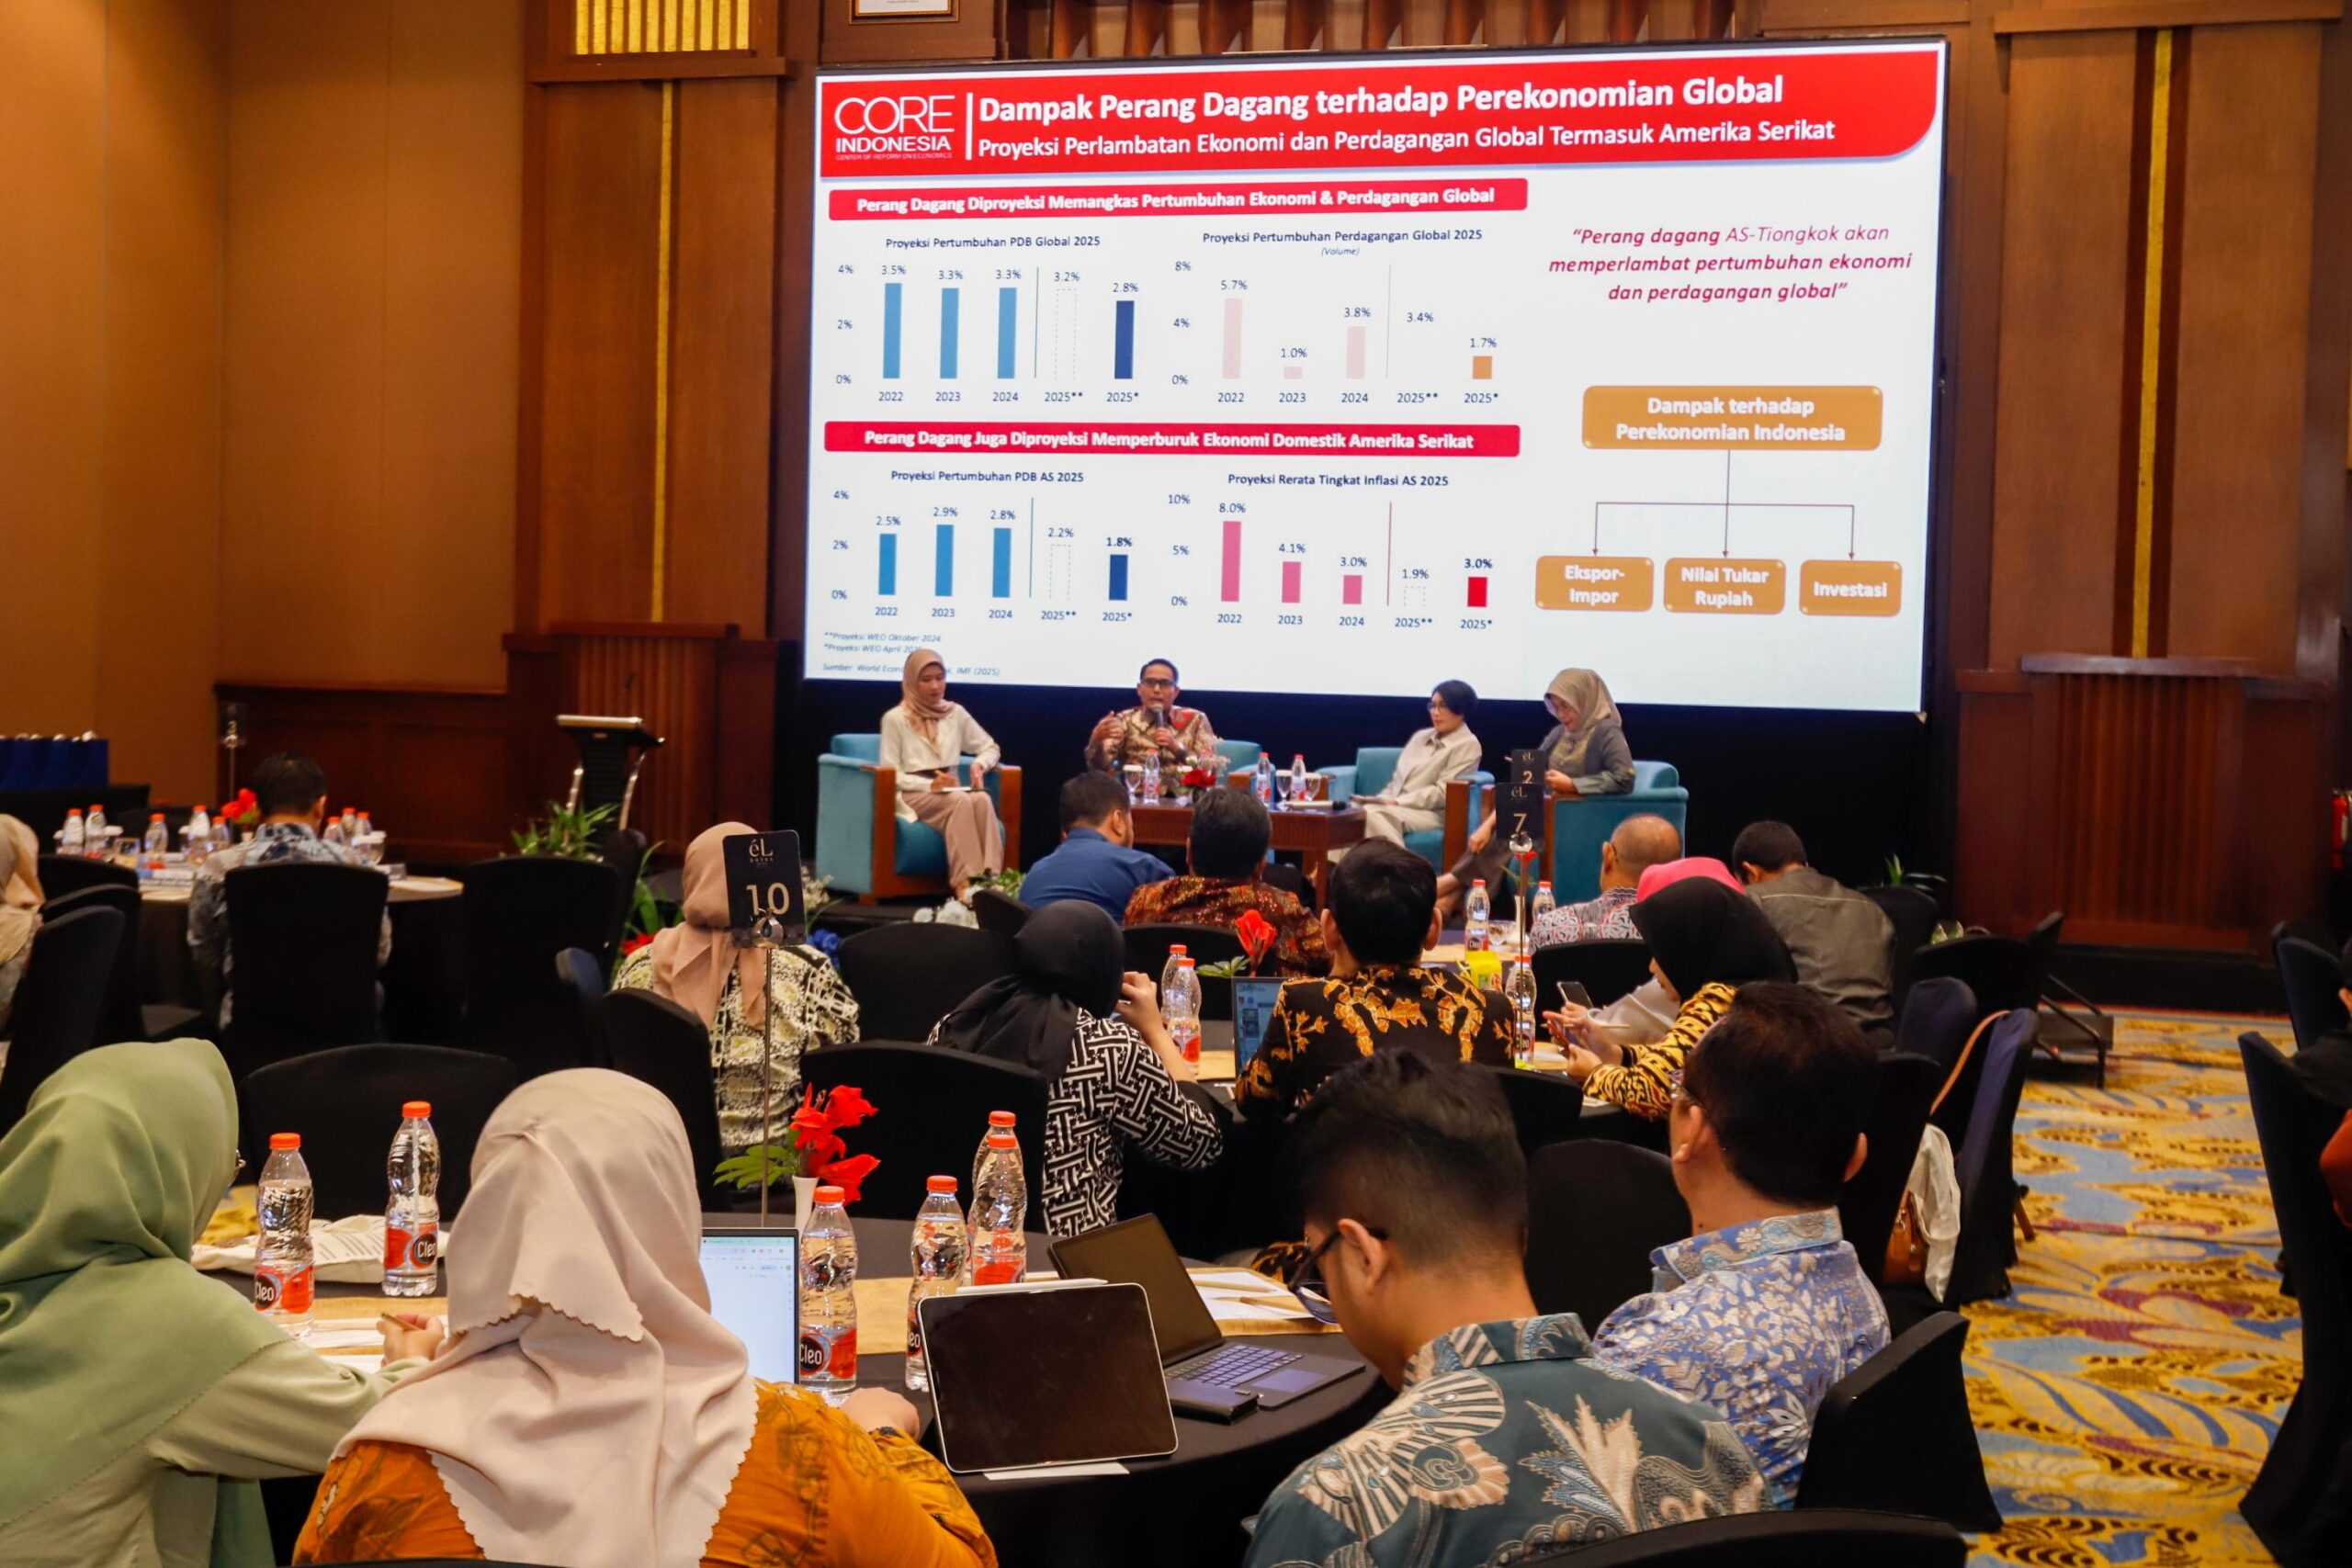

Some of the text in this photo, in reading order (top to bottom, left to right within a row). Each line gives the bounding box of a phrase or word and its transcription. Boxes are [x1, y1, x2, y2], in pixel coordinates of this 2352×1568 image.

[980, 75, 1782, 126] Dampak Perang Dagang terhadap Perekonomian Global
[834, 95, 956, 135] CORE
[836, 135, 951, 152] INDONESIA
[979, 119, 1835, 160] Proyeksi Perlambatan Ekonomi dan Perdagangan Global Termasuk Amerika Serikat
[858, 187, 1494, 214] Perang Dagang Diproyeksi Memangkas Pertumbuhan Ekonomi & Perdagangan Global
[1204, 230, 1482, 244] Proyeksi Pertumbuhan Perdagangan Global 2025
[1651, 228, 1720, 246] dagang
[1725, 225, 1838, 244] AS-Tiongkok
[1845, 225, 1889, 241] akan
[887, 236, 1100, 249] Proyeksi Pertumbuhan PDB Global 2025
[838, 265, 854, 274] 4%
[1175, 261, 1191, 271] 8%
[1549, 254, 1912, 275] memperlambat pertumbuhan ekonomi
[882, 265, 906, 275] 3.5%
[939, 270, 963, 279] 3.3%
[996, 269, 1021, 279] 3.3%
[1055, 272, 1080, 282] 3.2%
[1114, 283, 1138, 292] 2.8%
[1221, 280, 1247, 289] 5.7%
[1609, 285, 1642, 299] dan
[1647, 284, 1771, 303] perdagangan
[1344, 308, 1371, 317] 3.8%
[1408, 312, 1433, 322] 3.4%
[838, 320, 852, 329] 2%
[1173, 318, 1189, 327] 4%
[1471, 338, 1497, 347] 1.7%
[1282, 348, 1306, 357] 1.0%
[836, 375, 851, 384] 0%
[1172, 375, 1188, 384] 0%
[878, 391, 903, 401] 2022
[935, 392, 960, 401] 2023
[993, 392, 1018, 401] 2024
[1218, 392, 1244, 402] 2022
[1279, 392, 1306, 402] 2023
[1341, 393, 1368, 402] 2024
[1648, 397, 1815, 417] Dampak terhadap
[1616, 423, 1845, 441] Perekonomian Indonesia
[865, 431, 1474, 448] Perang Dagang Juga Diproyeksi Memperburuk Ekonomi Domestik Amerika Serikat
[891, 471, 1083, 481] Proyeksi Pertumbuhan PDB AS 2025
[1228, 474, 1448, 487] Proyeksi Rerata Tingkat Inflasi AS 2025
[834, 491, 849, 500] 4%
[1169, 494, 1190, 504] 10%
[933, 507, 958, 516] 2.9%
[1219, 503, 1246, 513] 8.0%
[990, 510, 1015, 520] 2.8%
[876, 516, 900, 525] 2.5%
[1048, 527, 1073, 537] 2.2%
[833, 540, 848, 549] 2%
[1107, 537, 1132, 547] 1.8%
[1173, 546, 1189, 555] 5%
[1279, 544, 1306, 553] 4.1%
[1340, 557, 1367, 567] 3.0%
[1464, 558, 1492, 569] 3.0%
[1403, 570, 1429, 579] 1.9%
[1565, 565, 1624, 582] Ekspor-
[1681, 567, 1769, 583] Nilai Tukar
[1814, 581, 1887, 597] Investasi
[831, 590, 847, 599] 0%
[1570, 589, 1619, 606] Impor
[1695, 591, 1753, 608] Rupiah
[1171, 596, 1188, 606] 0%
[876, 607, 898, 616] 2022
[932, 608, 955, 617] 2023
[989, 609, 1012, 618] 2024
[1217, 614, 1241, 623] 2022
[1278, 615, 1303, 625] 2023
[1340, 616, 1364, 626] 2024
[1523, 771, 1532, 784] 2
[1513, 813, 1527, 833] 7
[745, 882, 790, 916] 10
